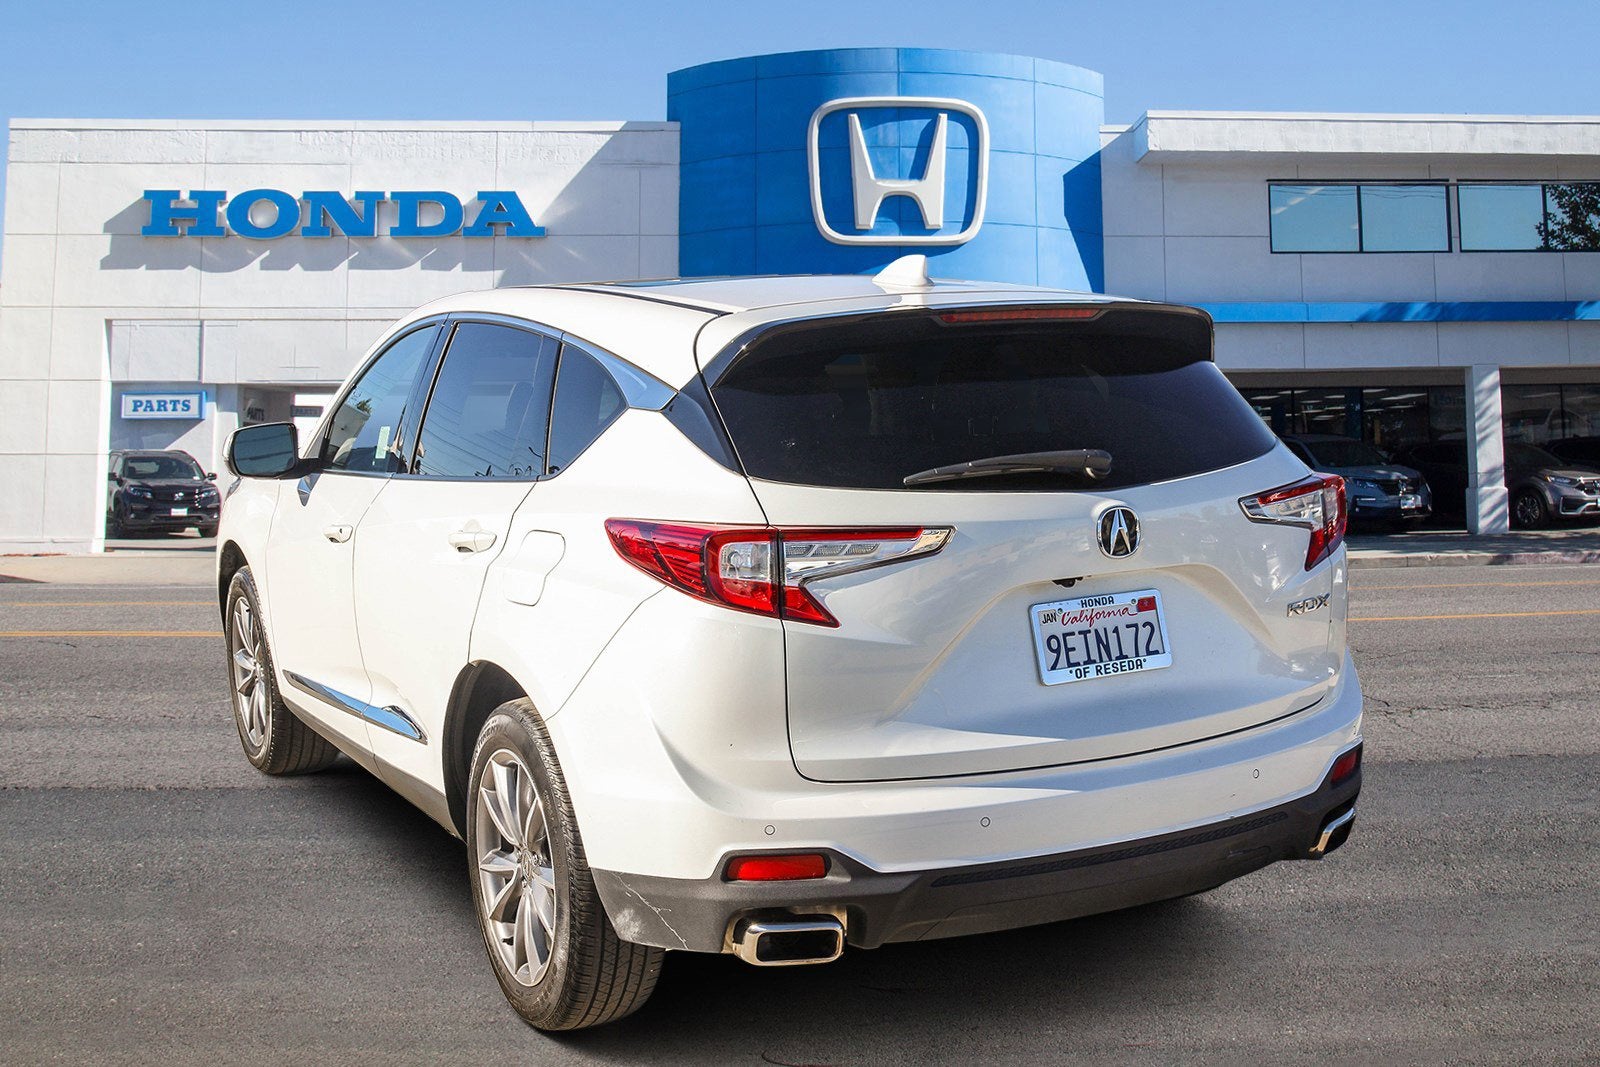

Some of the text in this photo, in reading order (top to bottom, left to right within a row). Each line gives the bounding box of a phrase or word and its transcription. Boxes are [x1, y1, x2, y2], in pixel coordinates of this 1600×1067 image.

[141, 188, 548, 239] HONDA
[132, 399, 191, 412] PARTS
[1081, 596, 1115, 608] HONDA
[1287, 593, 1330, 617] RDX
[1042, 612, 1057, 624] JAN
[1061, 607, 1138, 628] California
[1046, 621, 1159, 671] 9EIN172
[1075, 659, 1143, 679] OF RESEDA
